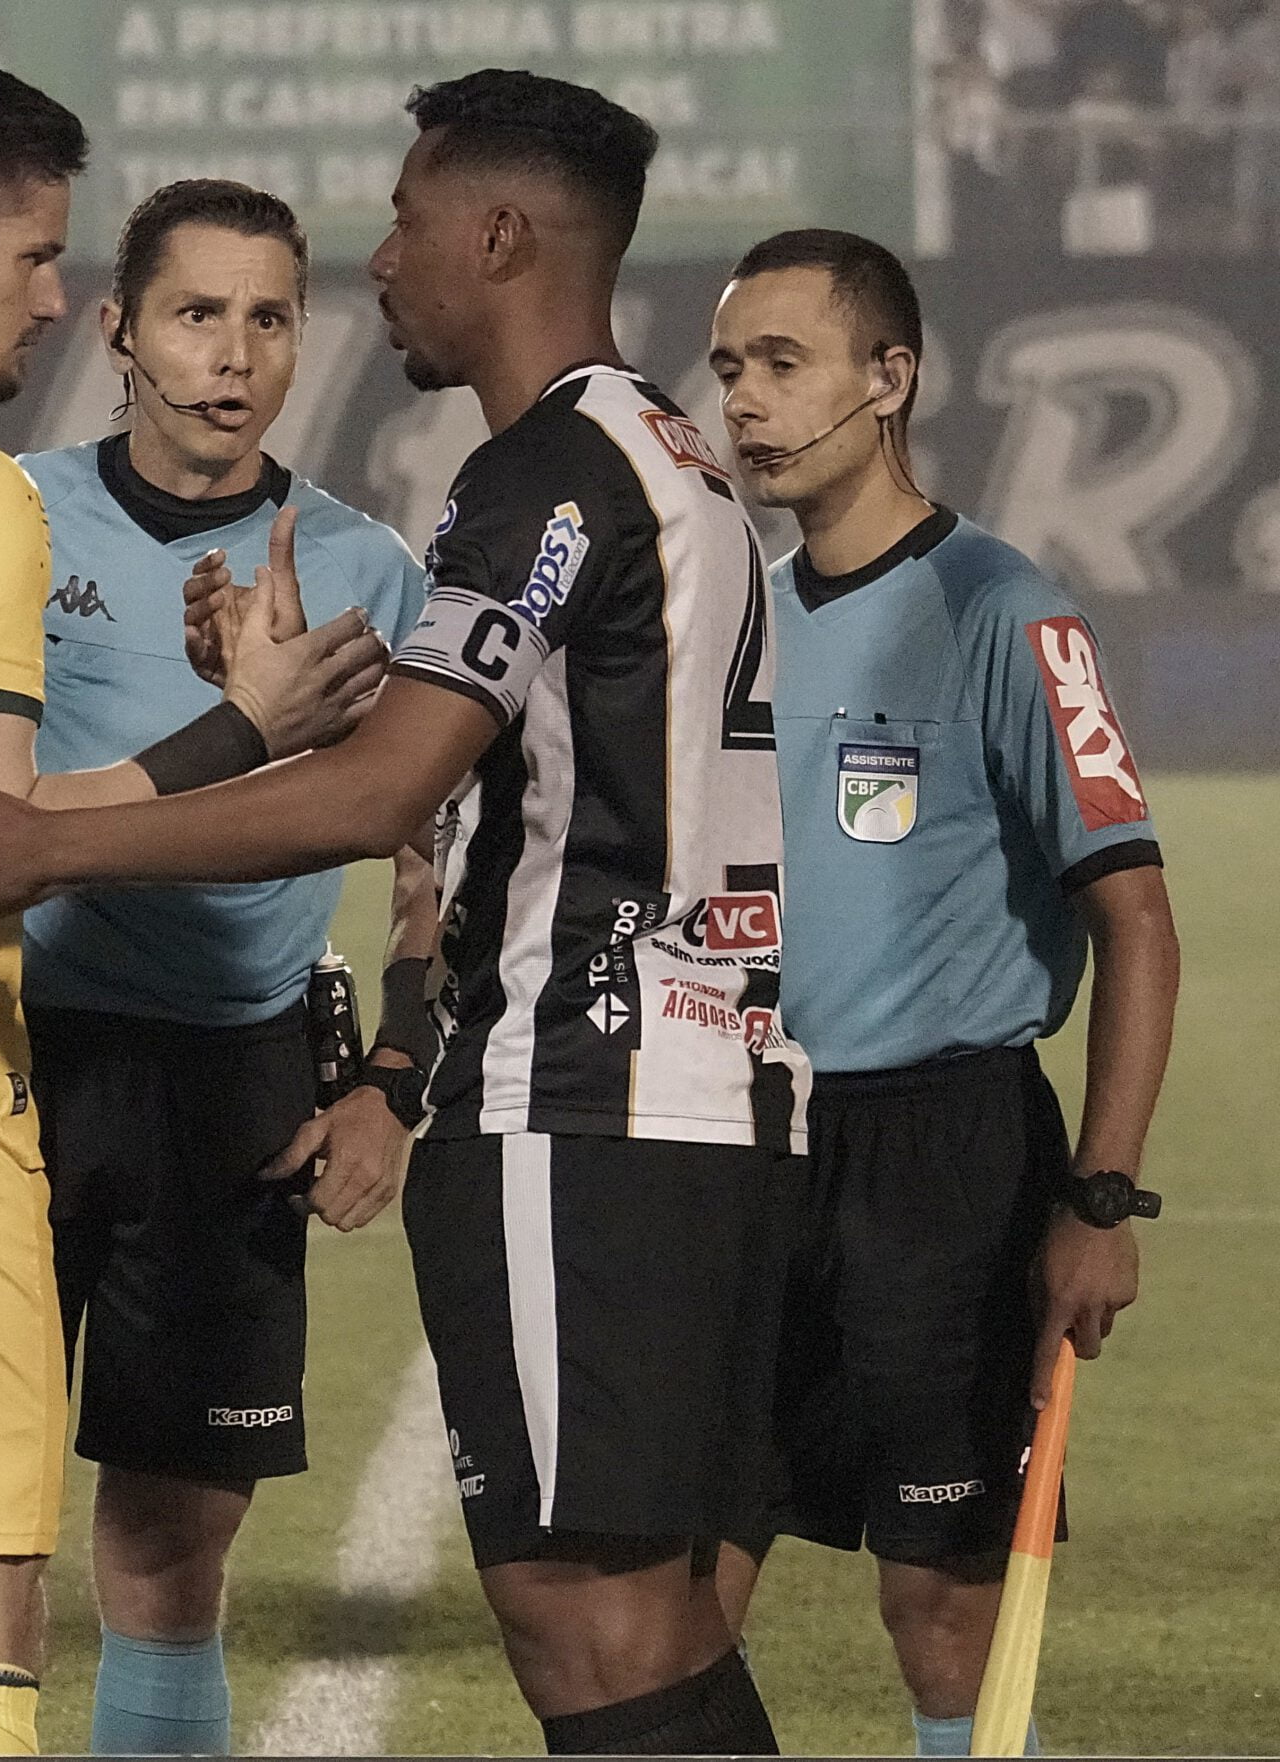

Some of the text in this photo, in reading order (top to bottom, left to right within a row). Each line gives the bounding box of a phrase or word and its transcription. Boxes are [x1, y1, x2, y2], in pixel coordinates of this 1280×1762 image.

[220, 76, 412, 128] CAMP
[460, 608, 521, 682] C
[1040, 623, 1144, 804] SKY
[843, 754, 915, 768] ASSISTENTE
[847, 780, 880, 796] CBF
[651, 937, 695, 965] assim
[696, 957, 737, 967] com
[678, 980, 726, 1001] HONDA
[661, 990, 741, 1031] Alagoas
[208, 1405, 293, 1427] Kappa
[899, 1479, 986, 1504] Kappa
